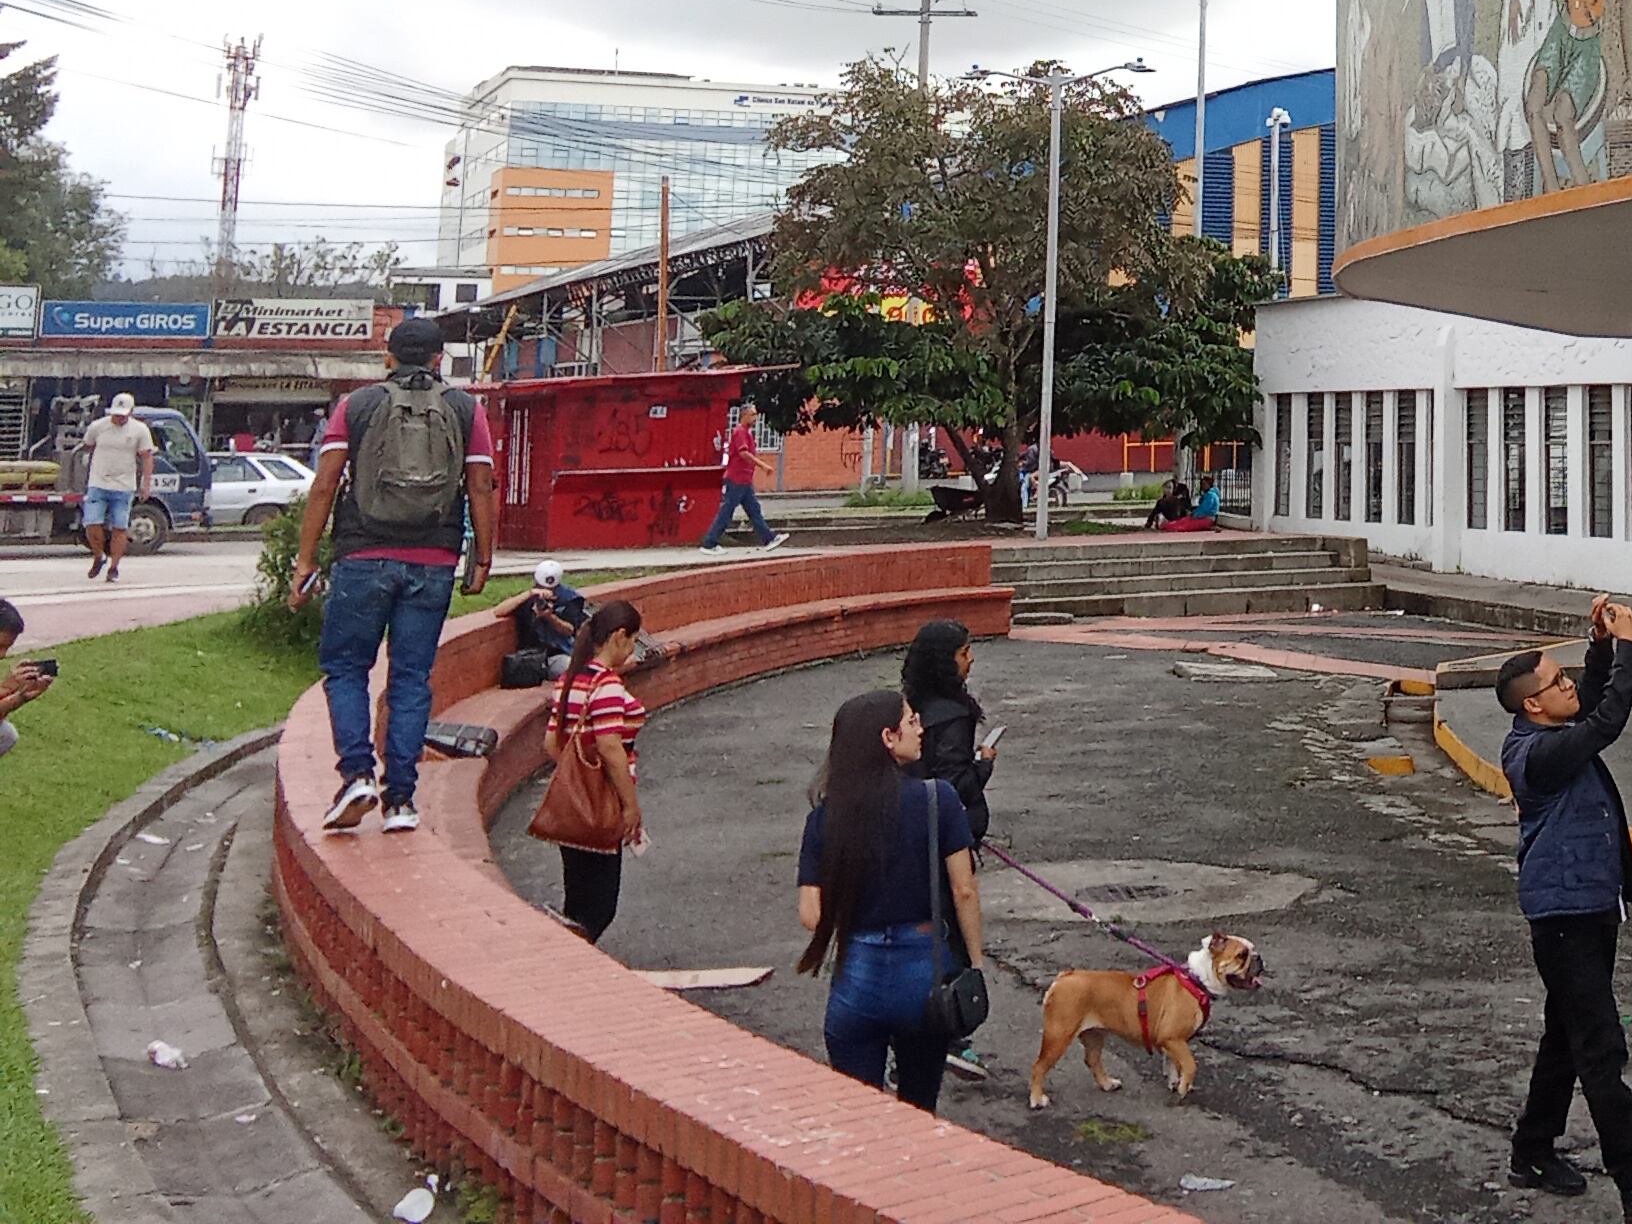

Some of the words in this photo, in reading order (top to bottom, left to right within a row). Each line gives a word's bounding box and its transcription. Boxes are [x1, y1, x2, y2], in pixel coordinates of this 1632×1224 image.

[243, 305, 344, 317] Minimarket
[215, 321, 248, 336] LA
[256, 322, 369, 336] ESTANCIA
